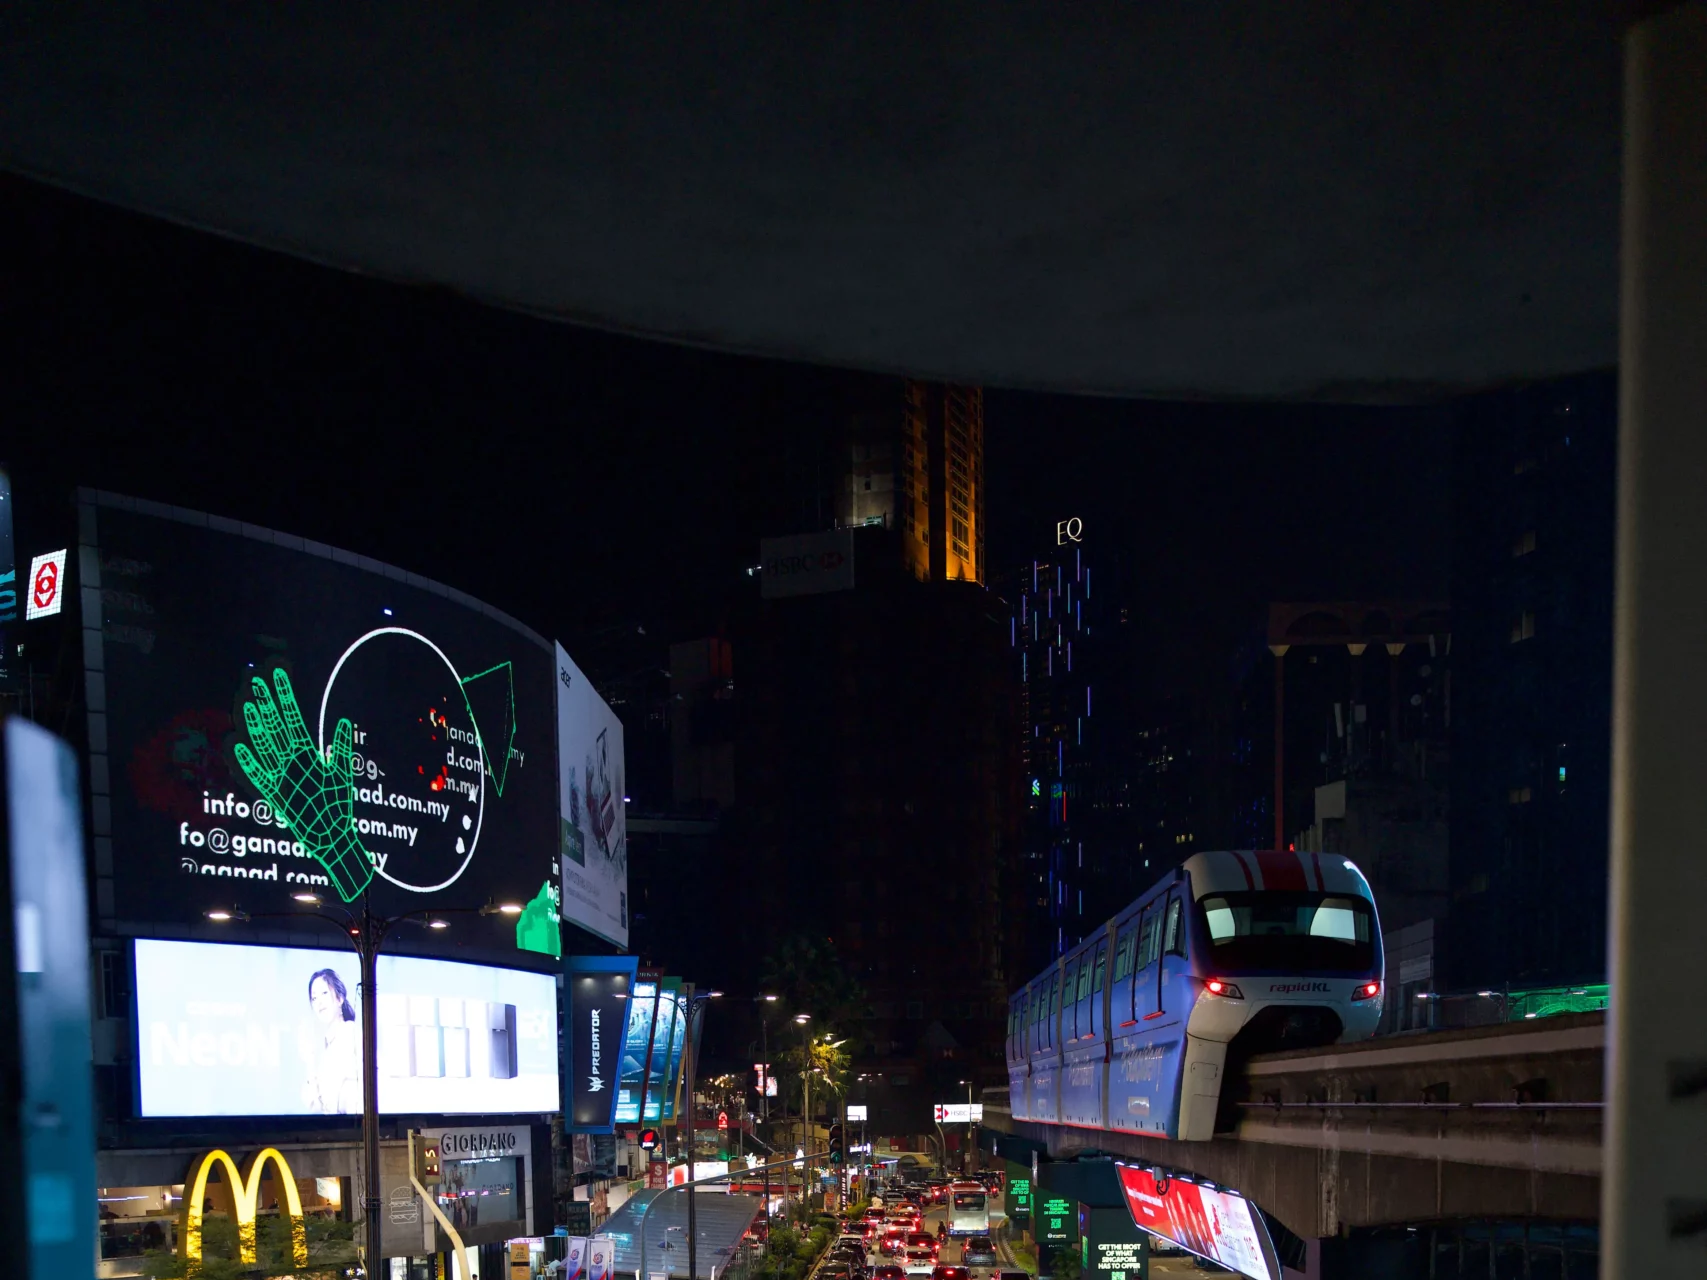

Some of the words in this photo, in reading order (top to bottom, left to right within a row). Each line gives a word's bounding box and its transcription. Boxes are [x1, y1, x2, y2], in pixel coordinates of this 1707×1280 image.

[1057, 517, 1083, 546] EQ
[1270, 982, 1331, 994] rapidKL
[591, 1008, 602, 1075] PREDATOR
[441, 1133, 516, 1156] GIORDANO
[1098, 1262, 1111, 1270] HAS
